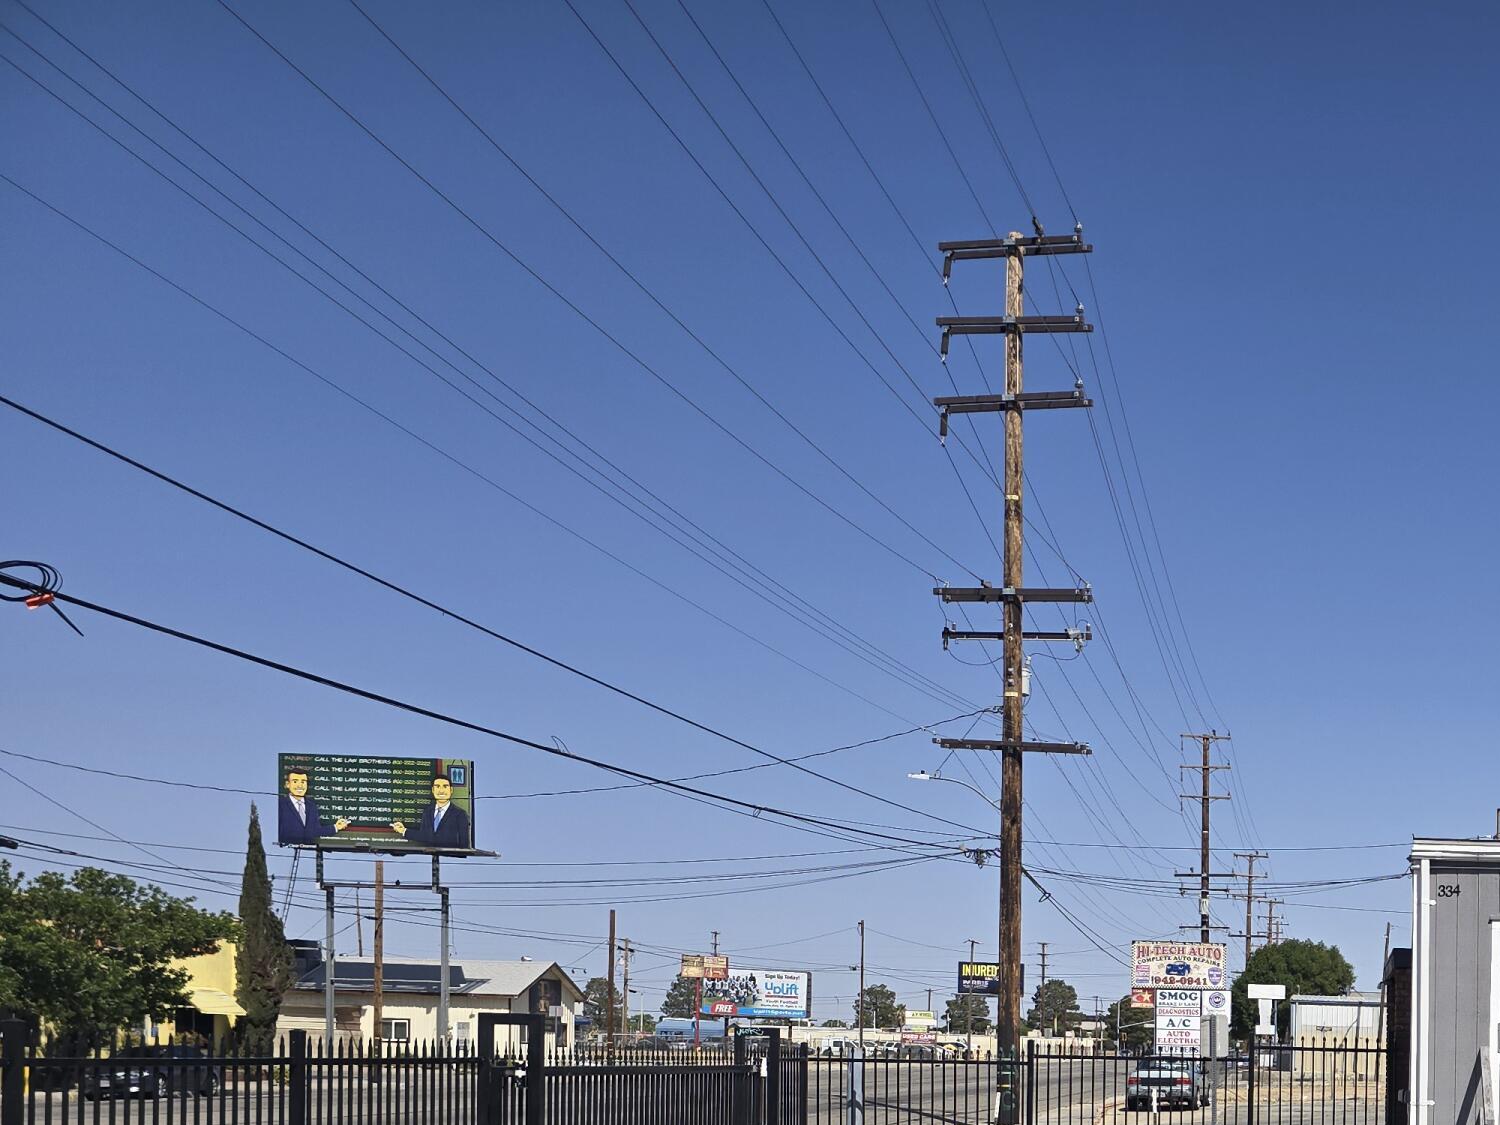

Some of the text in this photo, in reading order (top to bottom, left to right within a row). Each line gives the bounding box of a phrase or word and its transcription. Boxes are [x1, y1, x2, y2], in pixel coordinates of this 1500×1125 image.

[1438, 884, 1461, 898] 334
[1136, 945, 1222, 960] HI-TECH AUTO
[1137, 955, 1172, 965] COMPLETE
[1159, 992, 1198, 1001] SMOG
[714, 1004, 734, 1013] FREE
